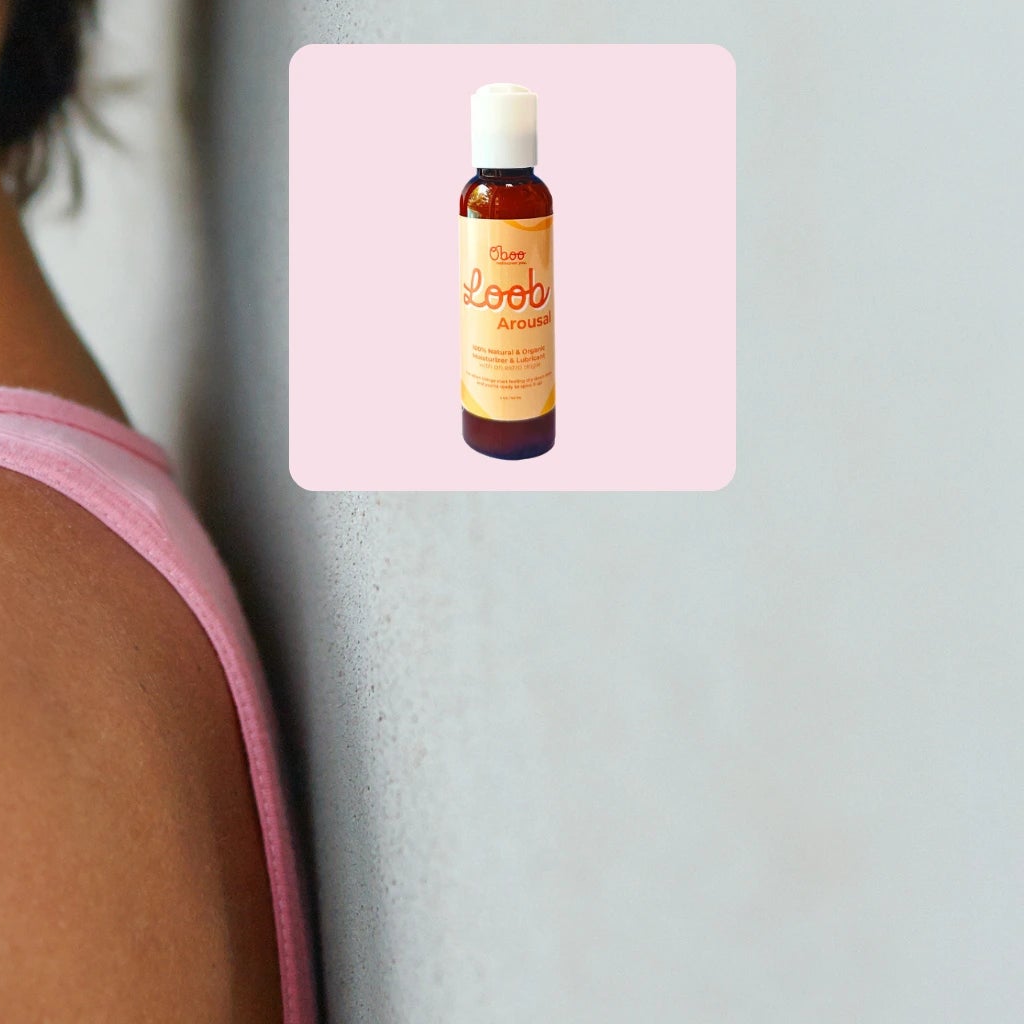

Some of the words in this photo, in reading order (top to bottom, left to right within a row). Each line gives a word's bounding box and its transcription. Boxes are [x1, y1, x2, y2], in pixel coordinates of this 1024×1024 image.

[490, 245, 526, 261] Oboo
[464, 268, 550, 310] Loob
[497, 311, 551, 330] Arousal
[472, 353, 508, 363] Moisturizer
[516, 354, 546, 363] Lubricant
[522, 345, 545, 355] Organic
